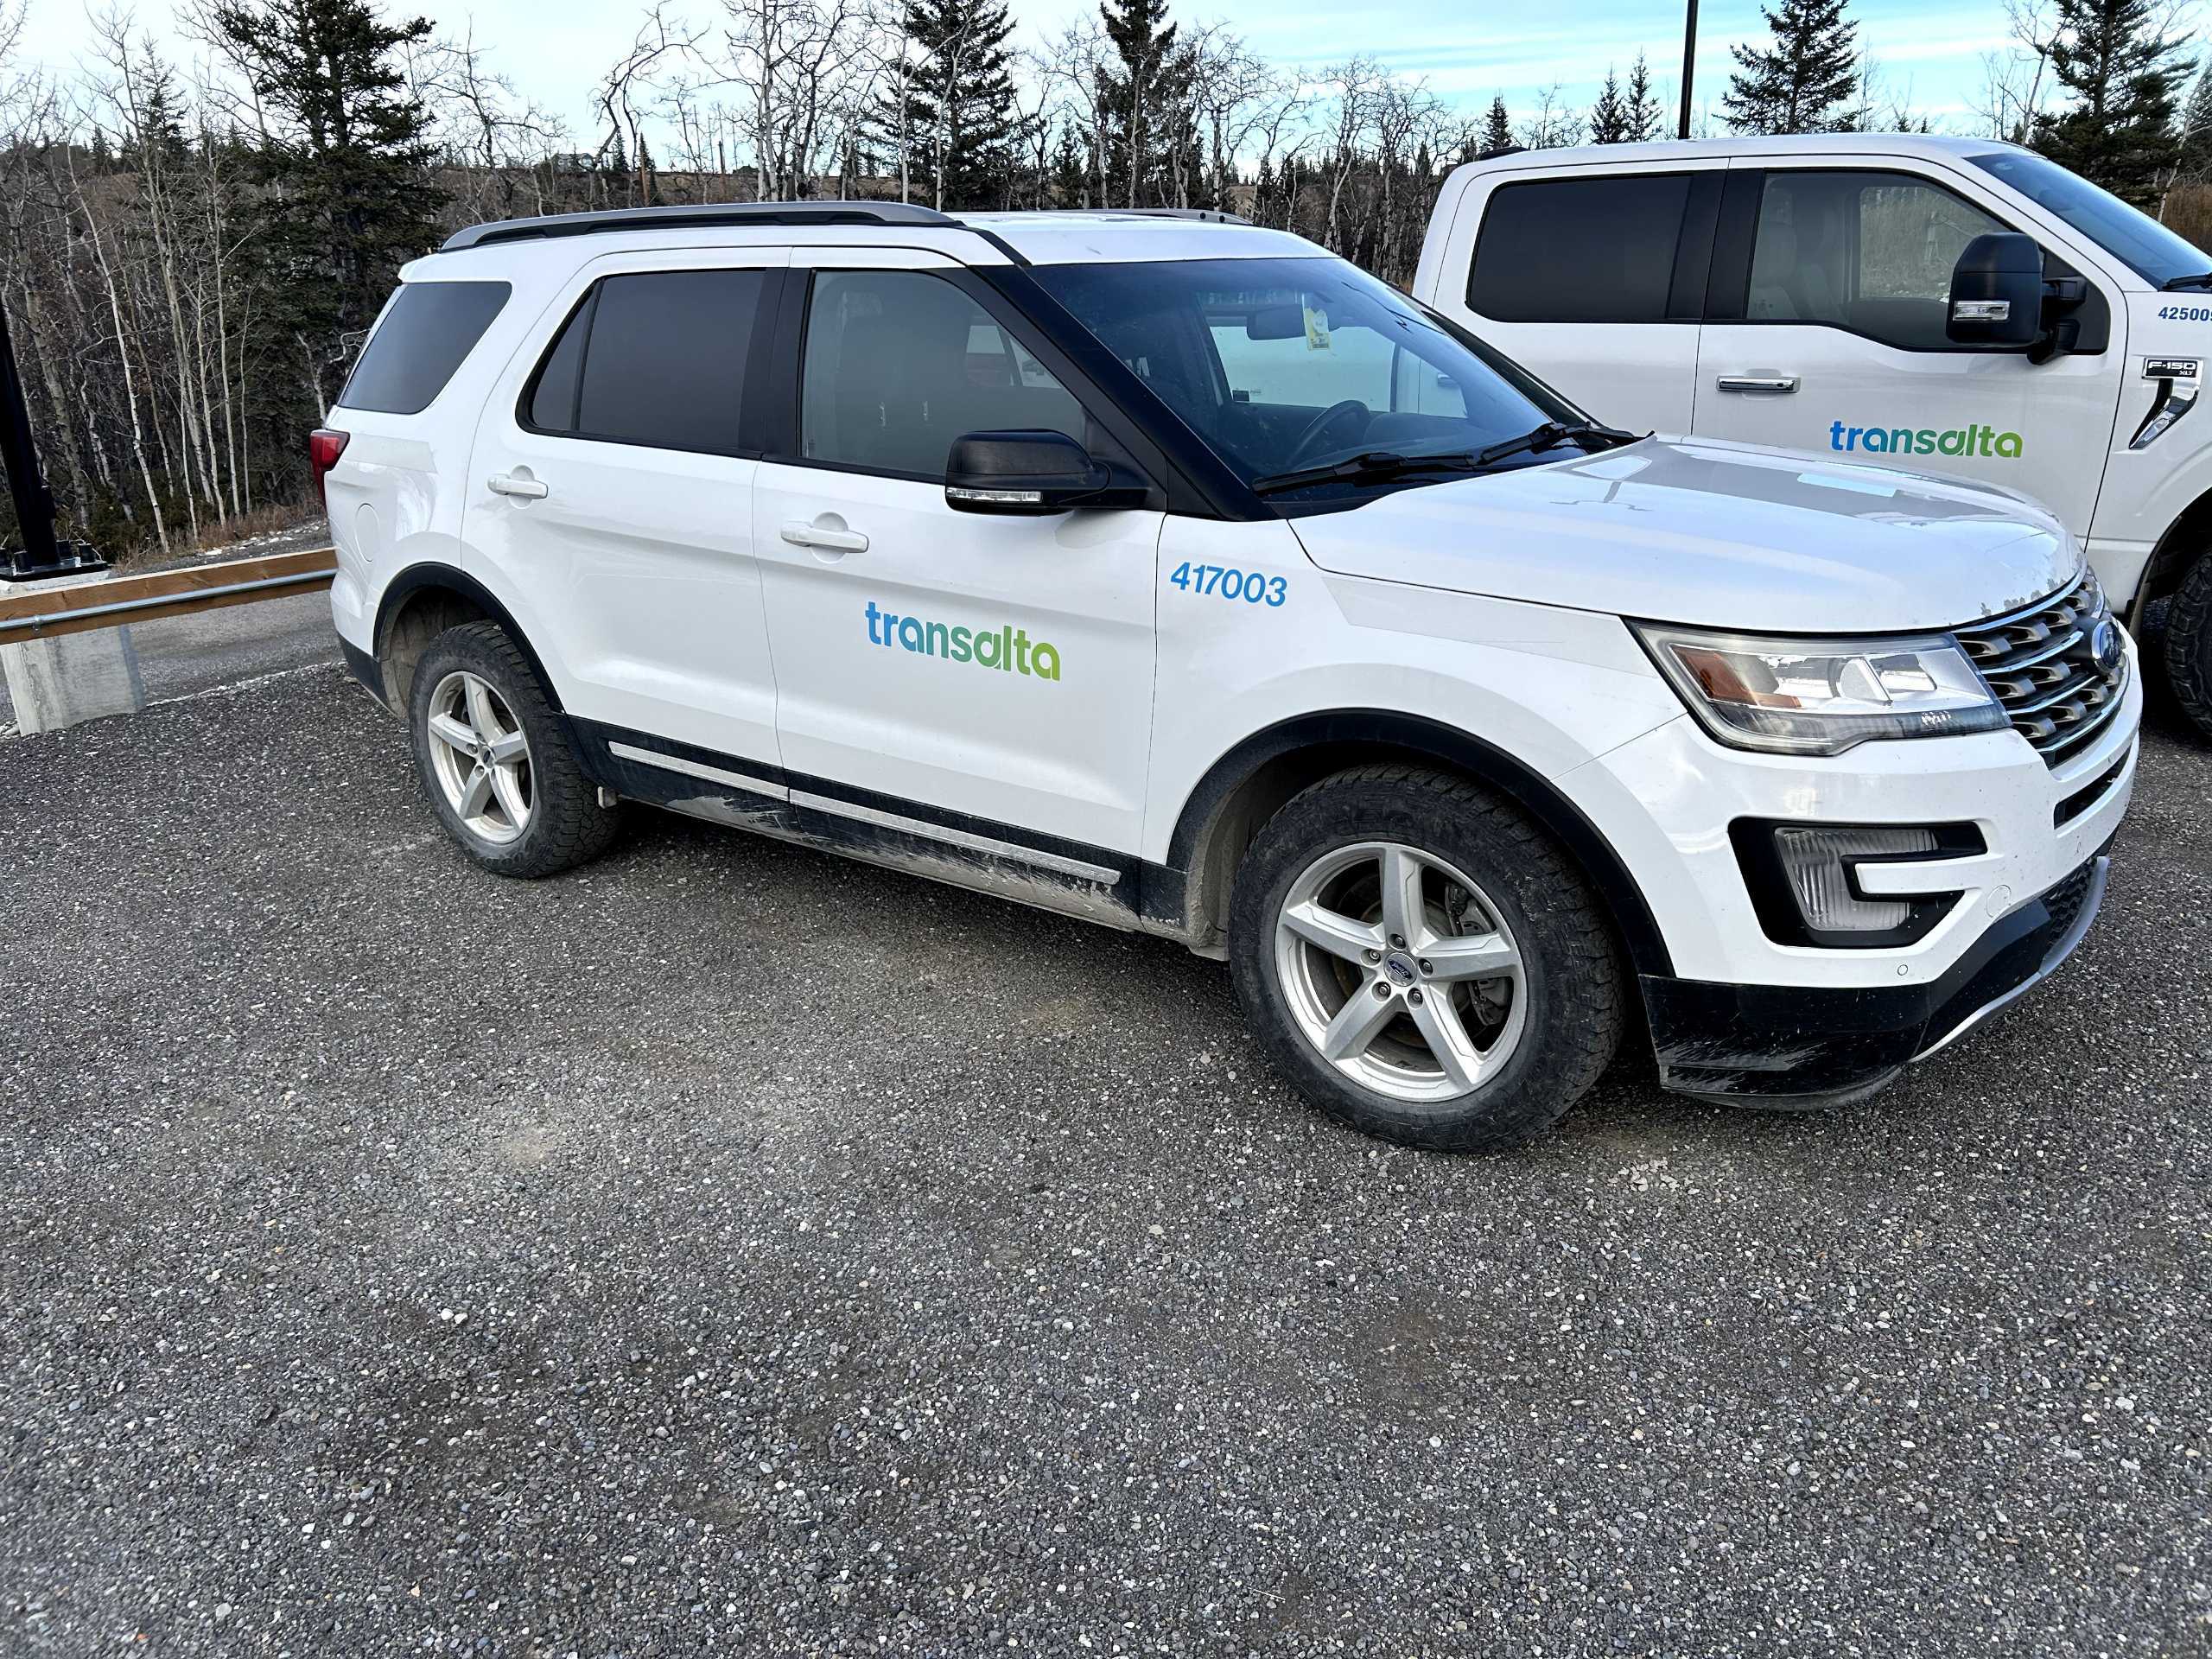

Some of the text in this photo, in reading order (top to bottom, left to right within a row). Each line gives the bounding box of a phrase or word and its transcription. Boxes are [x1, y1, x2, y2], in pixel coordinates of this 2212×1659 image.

[2148, 361, 2196, 370] F-150
[1829, 421, 2024, 458] transalta
[1171, 561, 1288, 607] 417003
[864, 601, 1061, 682] transalta
